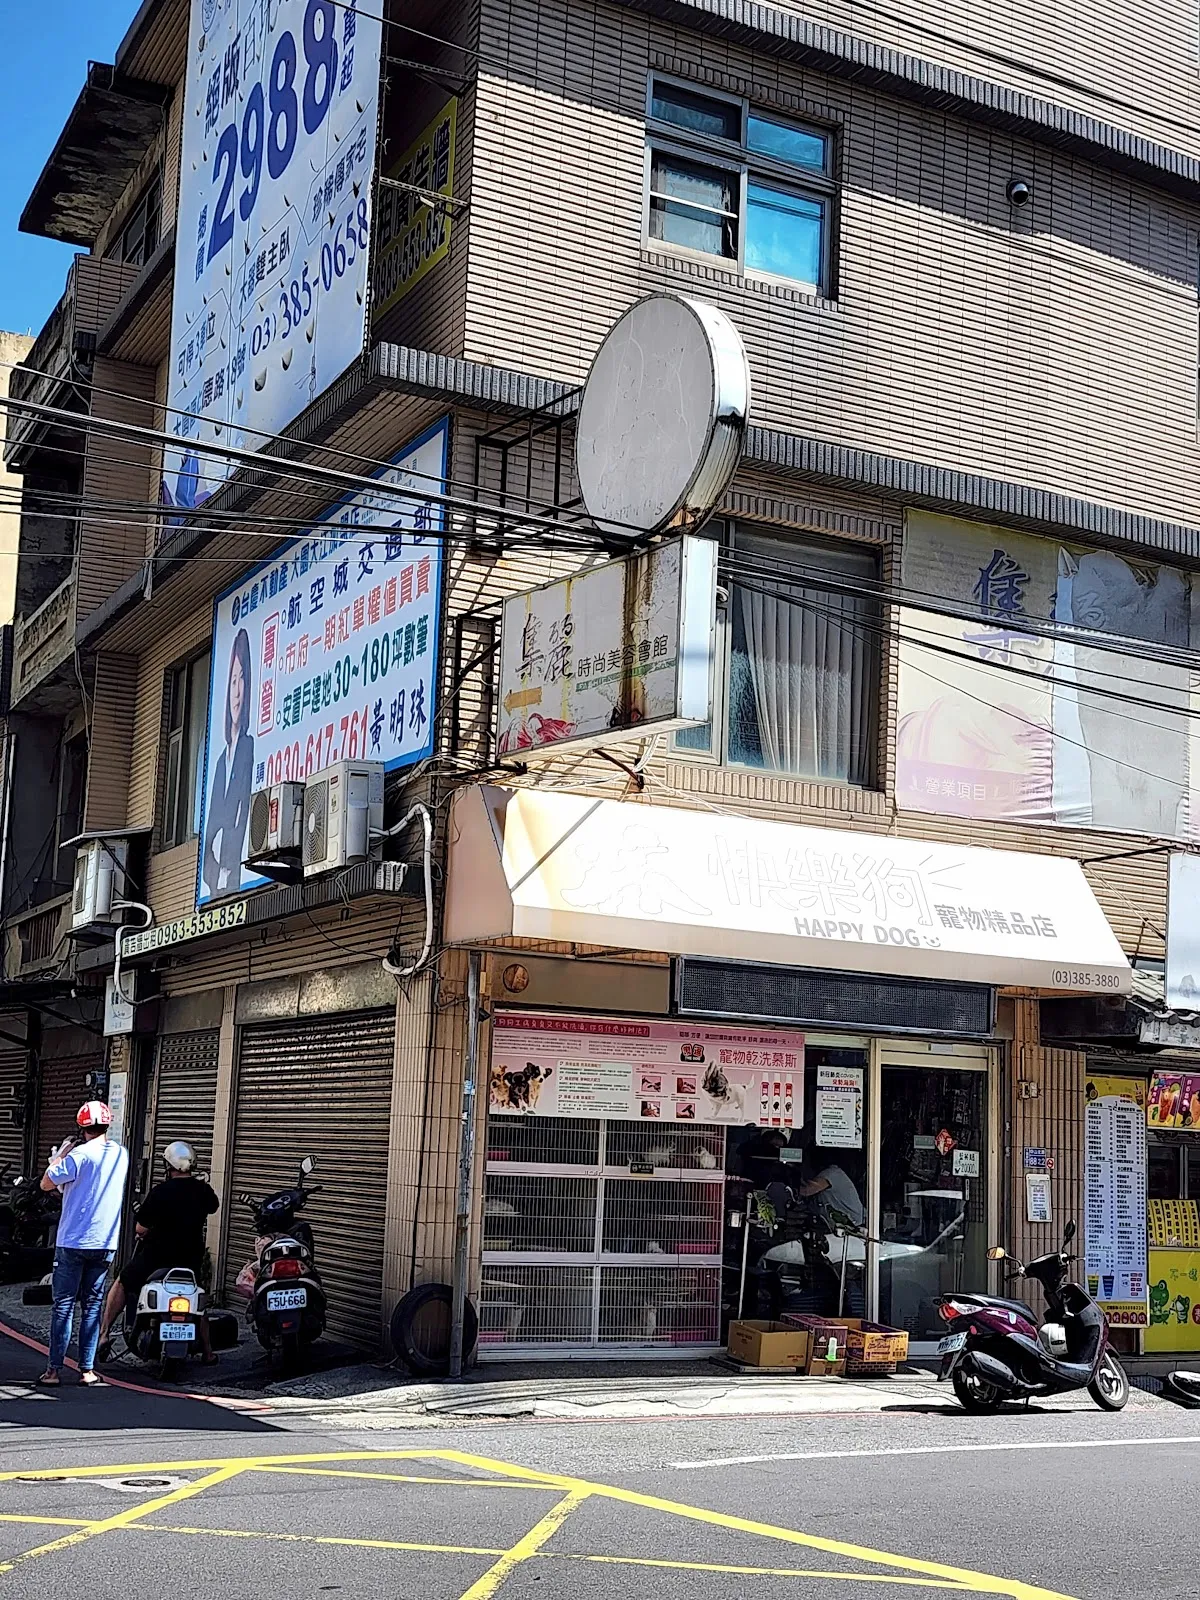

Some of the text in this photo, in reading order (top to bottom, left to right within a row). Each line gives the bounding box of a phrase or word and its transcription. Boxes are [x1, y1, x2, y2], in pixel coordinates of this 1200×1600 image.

[206, 0, 338, 267] 2988
[286, 501, 432, 629] 航空城交通部
[260, 622, 277, 726] 專營
[577, 634, 669, 678] 時尚美容會館
[255, 761, 267, 792] 請
[369, 678, 428, 754] 黃明珠
[925, 778, 987, 802] 營業項目
[708, 833, 934, 928] 快樂狗
[156, 903, 245, 946] 0983-553-852
[794, 916, 921, 948] HAPPY DOG
[933, 903, 1058, 939] 寵物精品店
[1050, 967, 1121, 989] (03)385-3880
[719, 1048, 798, 1069] 寵物乾洗慕斯
[267, 1294, 306, 1310] F5U-668
